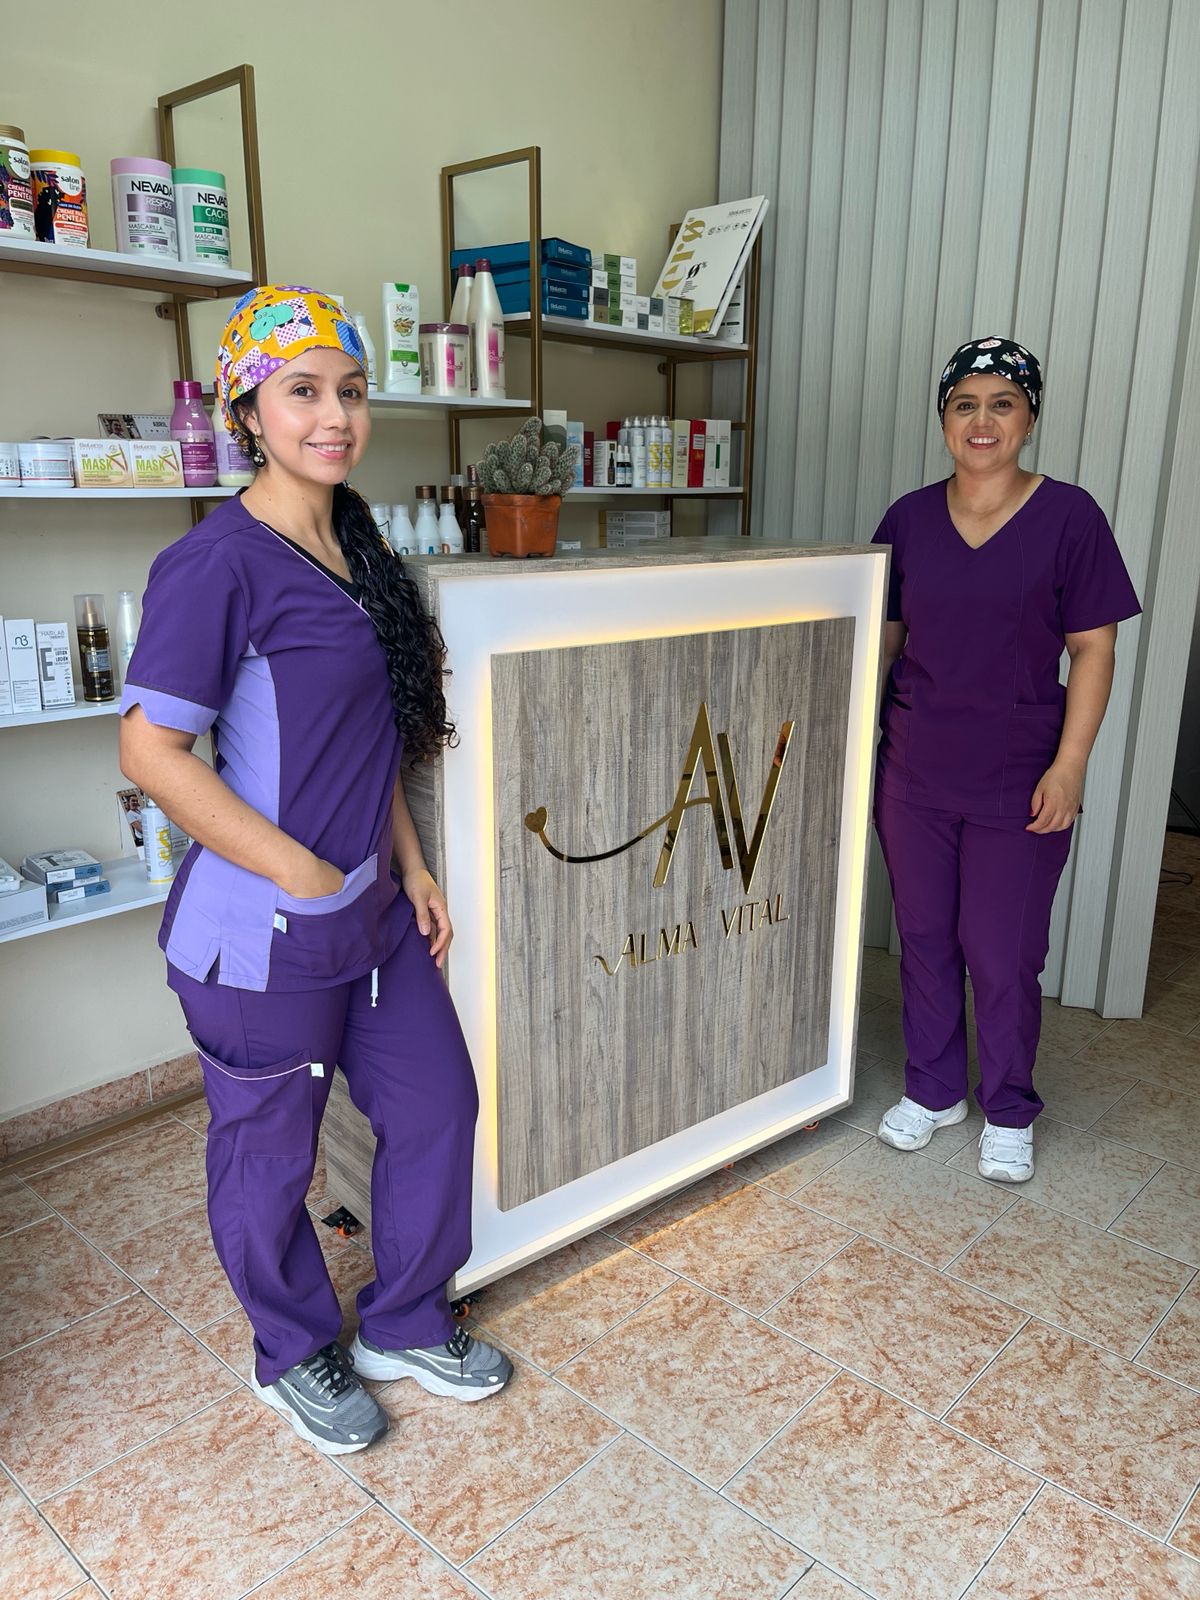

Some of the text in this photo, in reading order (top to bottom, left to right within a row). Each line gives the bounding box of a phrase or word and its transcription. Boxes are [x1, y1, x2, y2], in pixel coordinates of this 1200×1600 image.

[60, 176, 80, 185] salon
[131, 181, 174, 197] NEVADA
[82, 458, 113, 471] MASK
[136, 459, 165, 472] MASK
[653, 702, 795, 894] AV
[594, 894, 790, 976] ALMA VITAL
